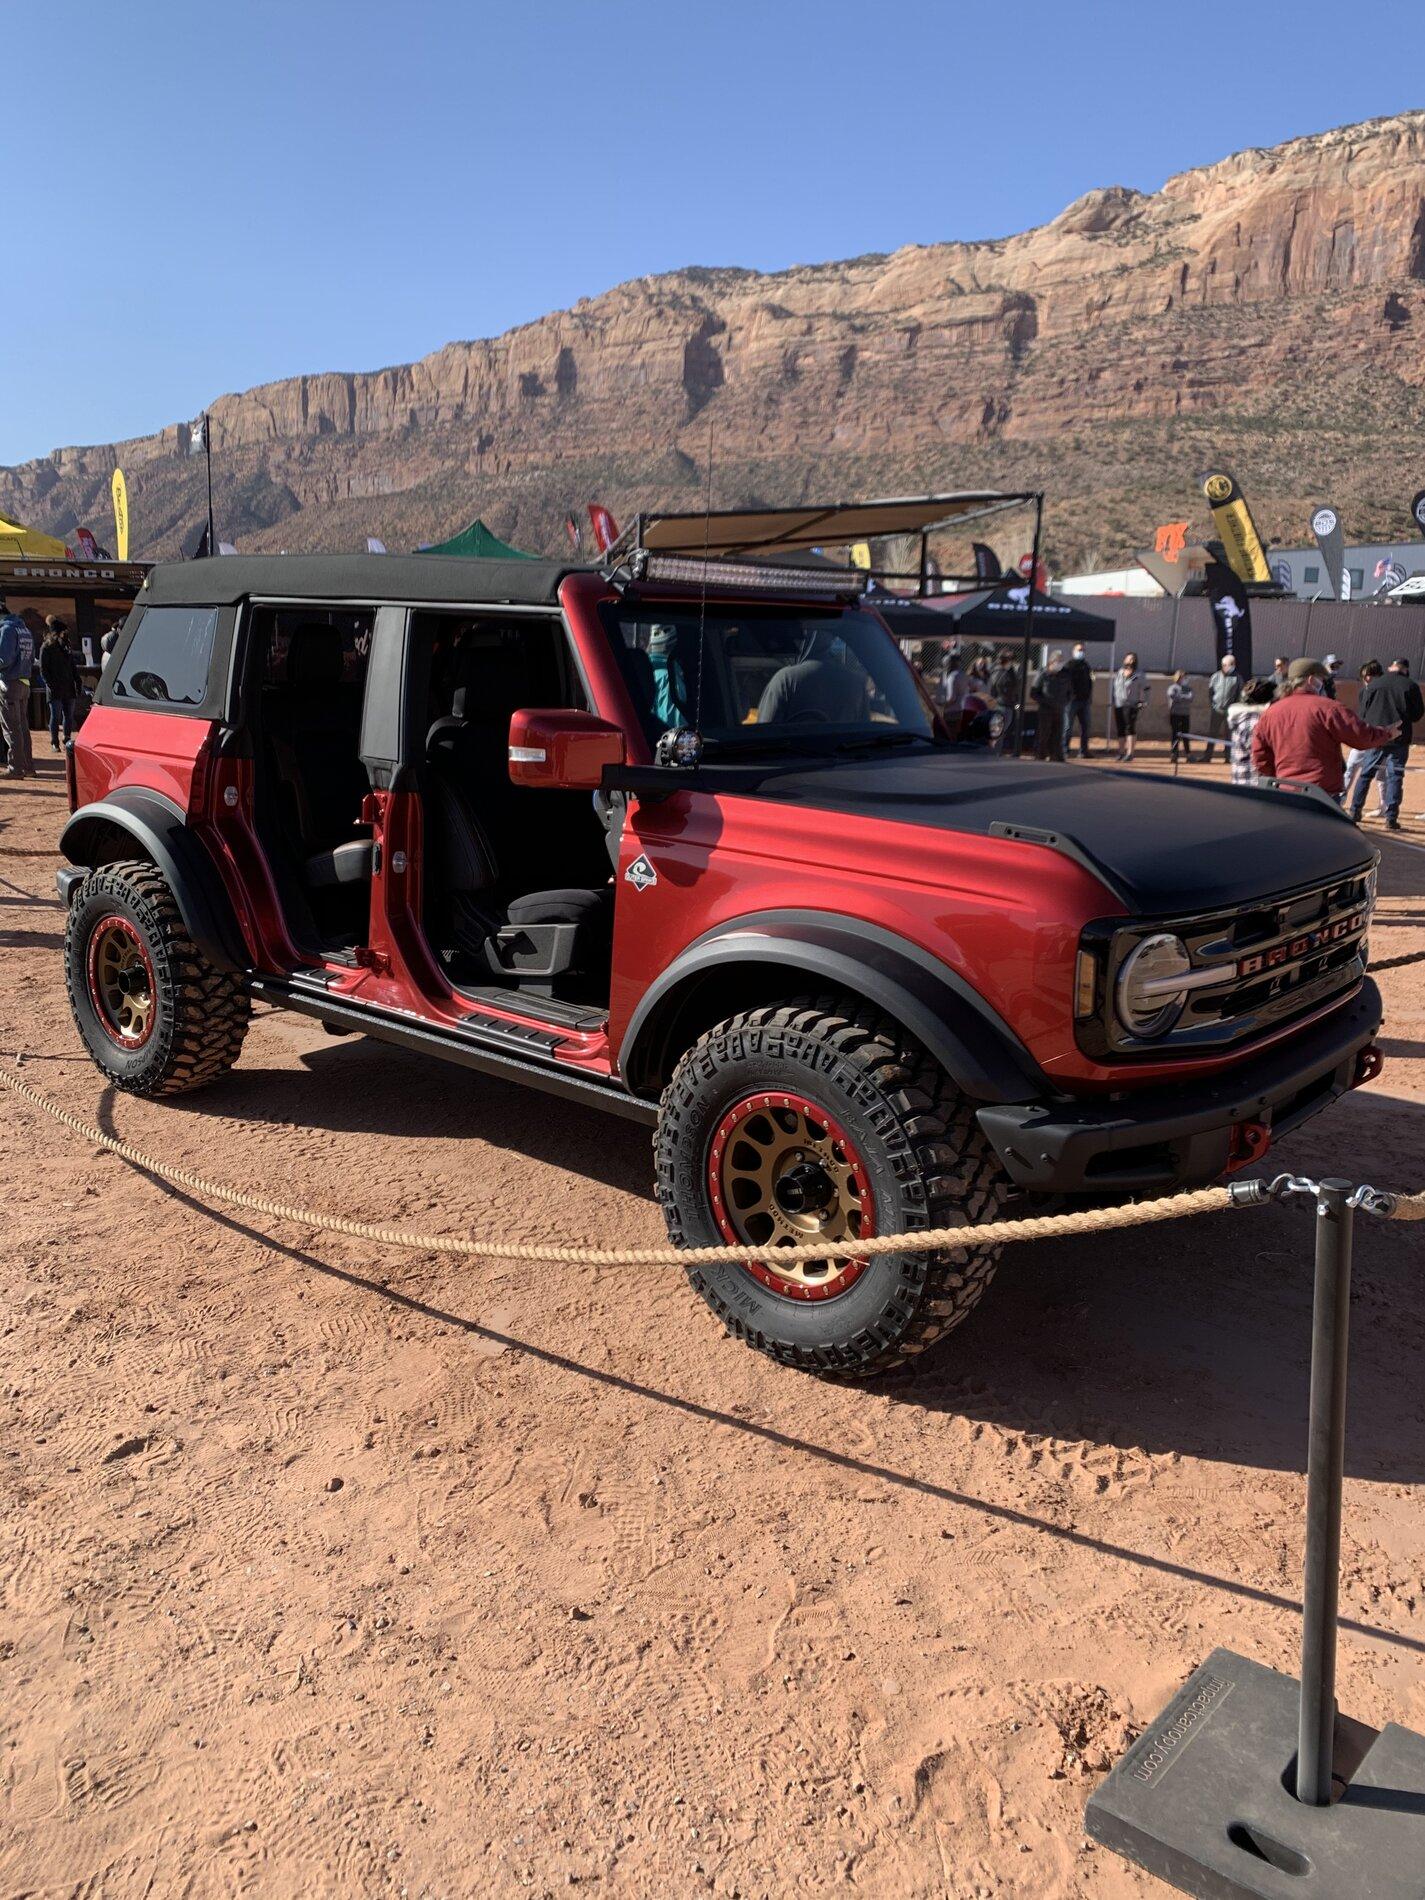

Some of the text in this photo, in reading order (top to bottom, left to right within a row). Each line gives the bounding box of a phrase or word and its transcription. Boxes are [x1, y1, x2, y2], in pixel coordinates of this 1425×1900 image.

[13, 567, 115, 579] BRONCO
[1240, 916, 1363, 976] BRONCO
[679, 1094, 711, 1222] THOMPSON
[711, 1261, 763, 1316] MICK
[1134, 1676, 1232, 1782] impactcanopy.com
